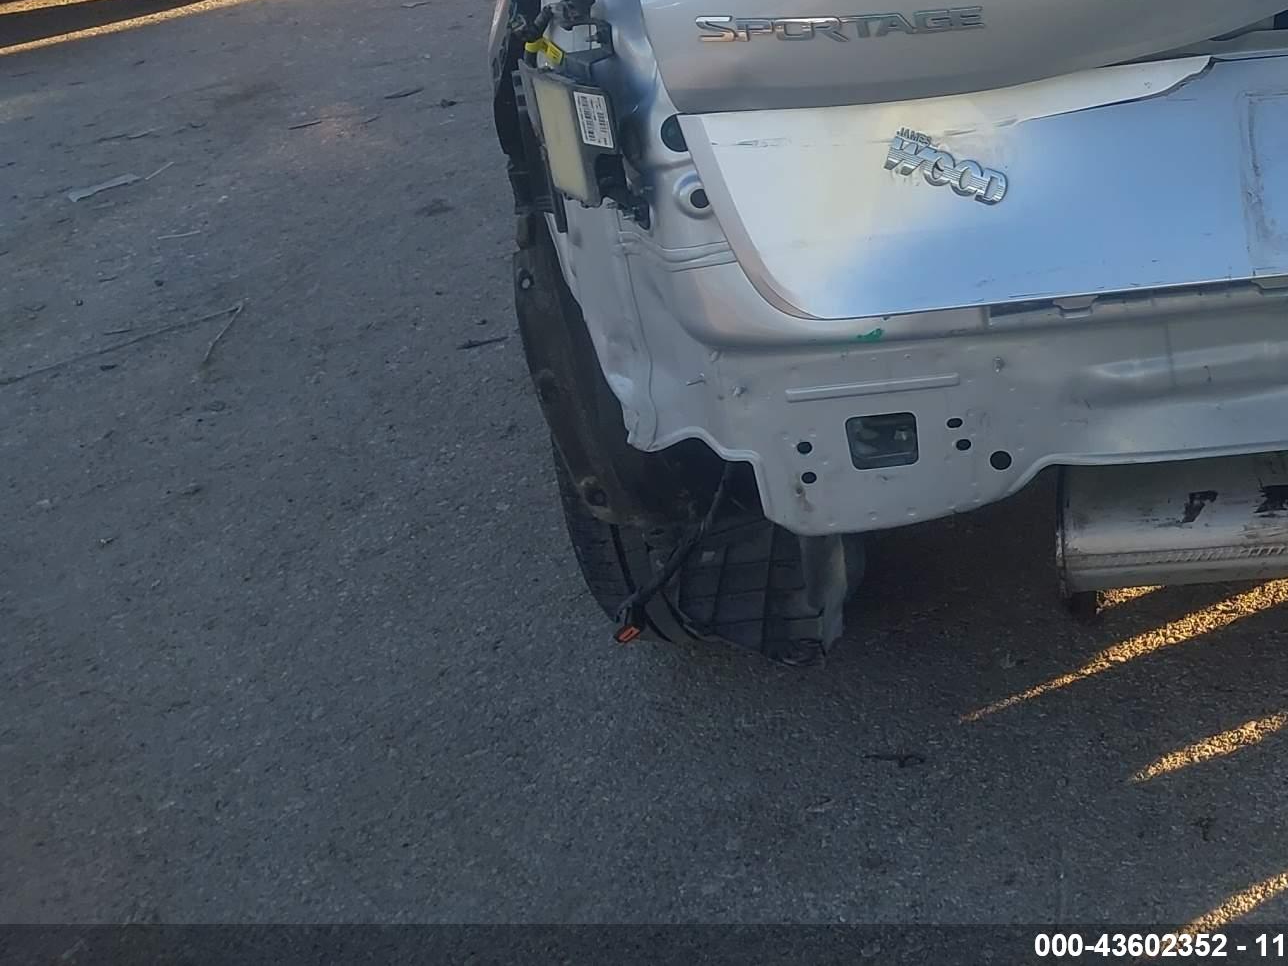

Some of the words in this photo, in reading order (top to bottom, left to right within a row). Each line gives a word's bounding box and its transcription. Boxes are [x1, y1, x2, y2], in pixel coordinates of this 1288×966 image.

[695, 5, 985, 42] SPORTAGE
[896, 127, 932, 146] JAMES
[884, 136, 1009, 206] WOOD
